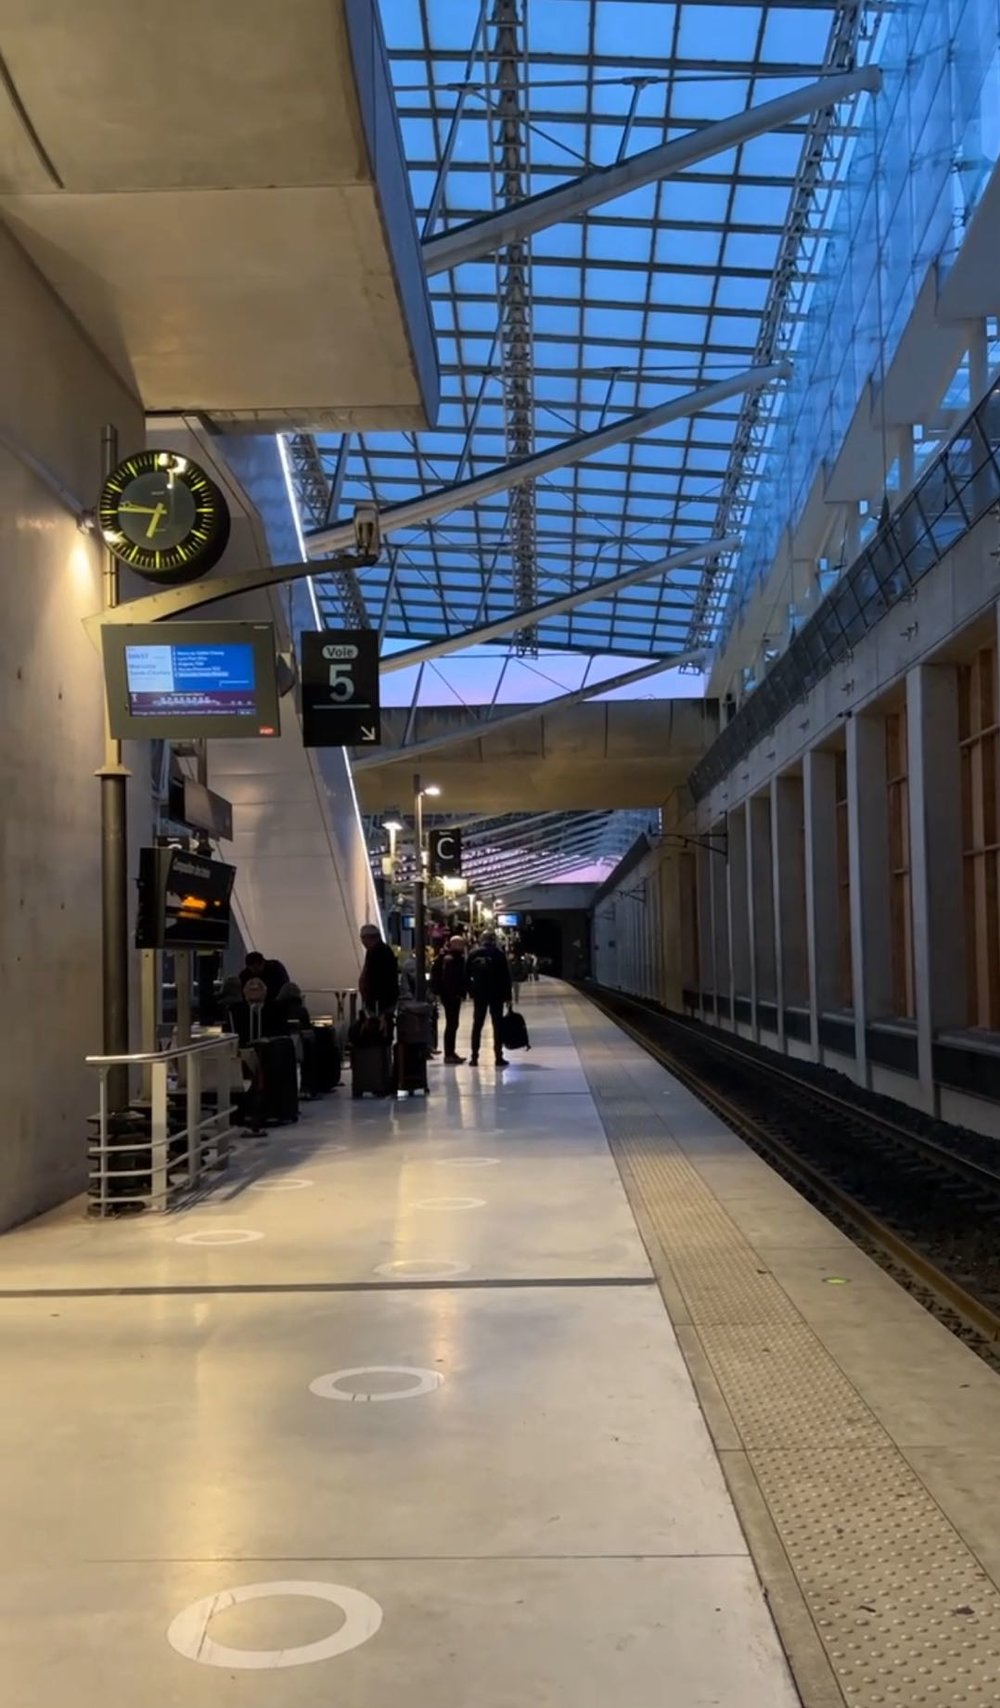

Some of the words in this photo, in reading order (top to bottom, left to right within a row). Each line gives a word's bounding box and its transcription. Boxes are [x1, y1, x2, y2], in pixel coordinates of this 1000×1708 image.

[326, 646, 354, 658] Voie
[329, 664, 354, 701] 5
[437, 837, 454, 859] C
